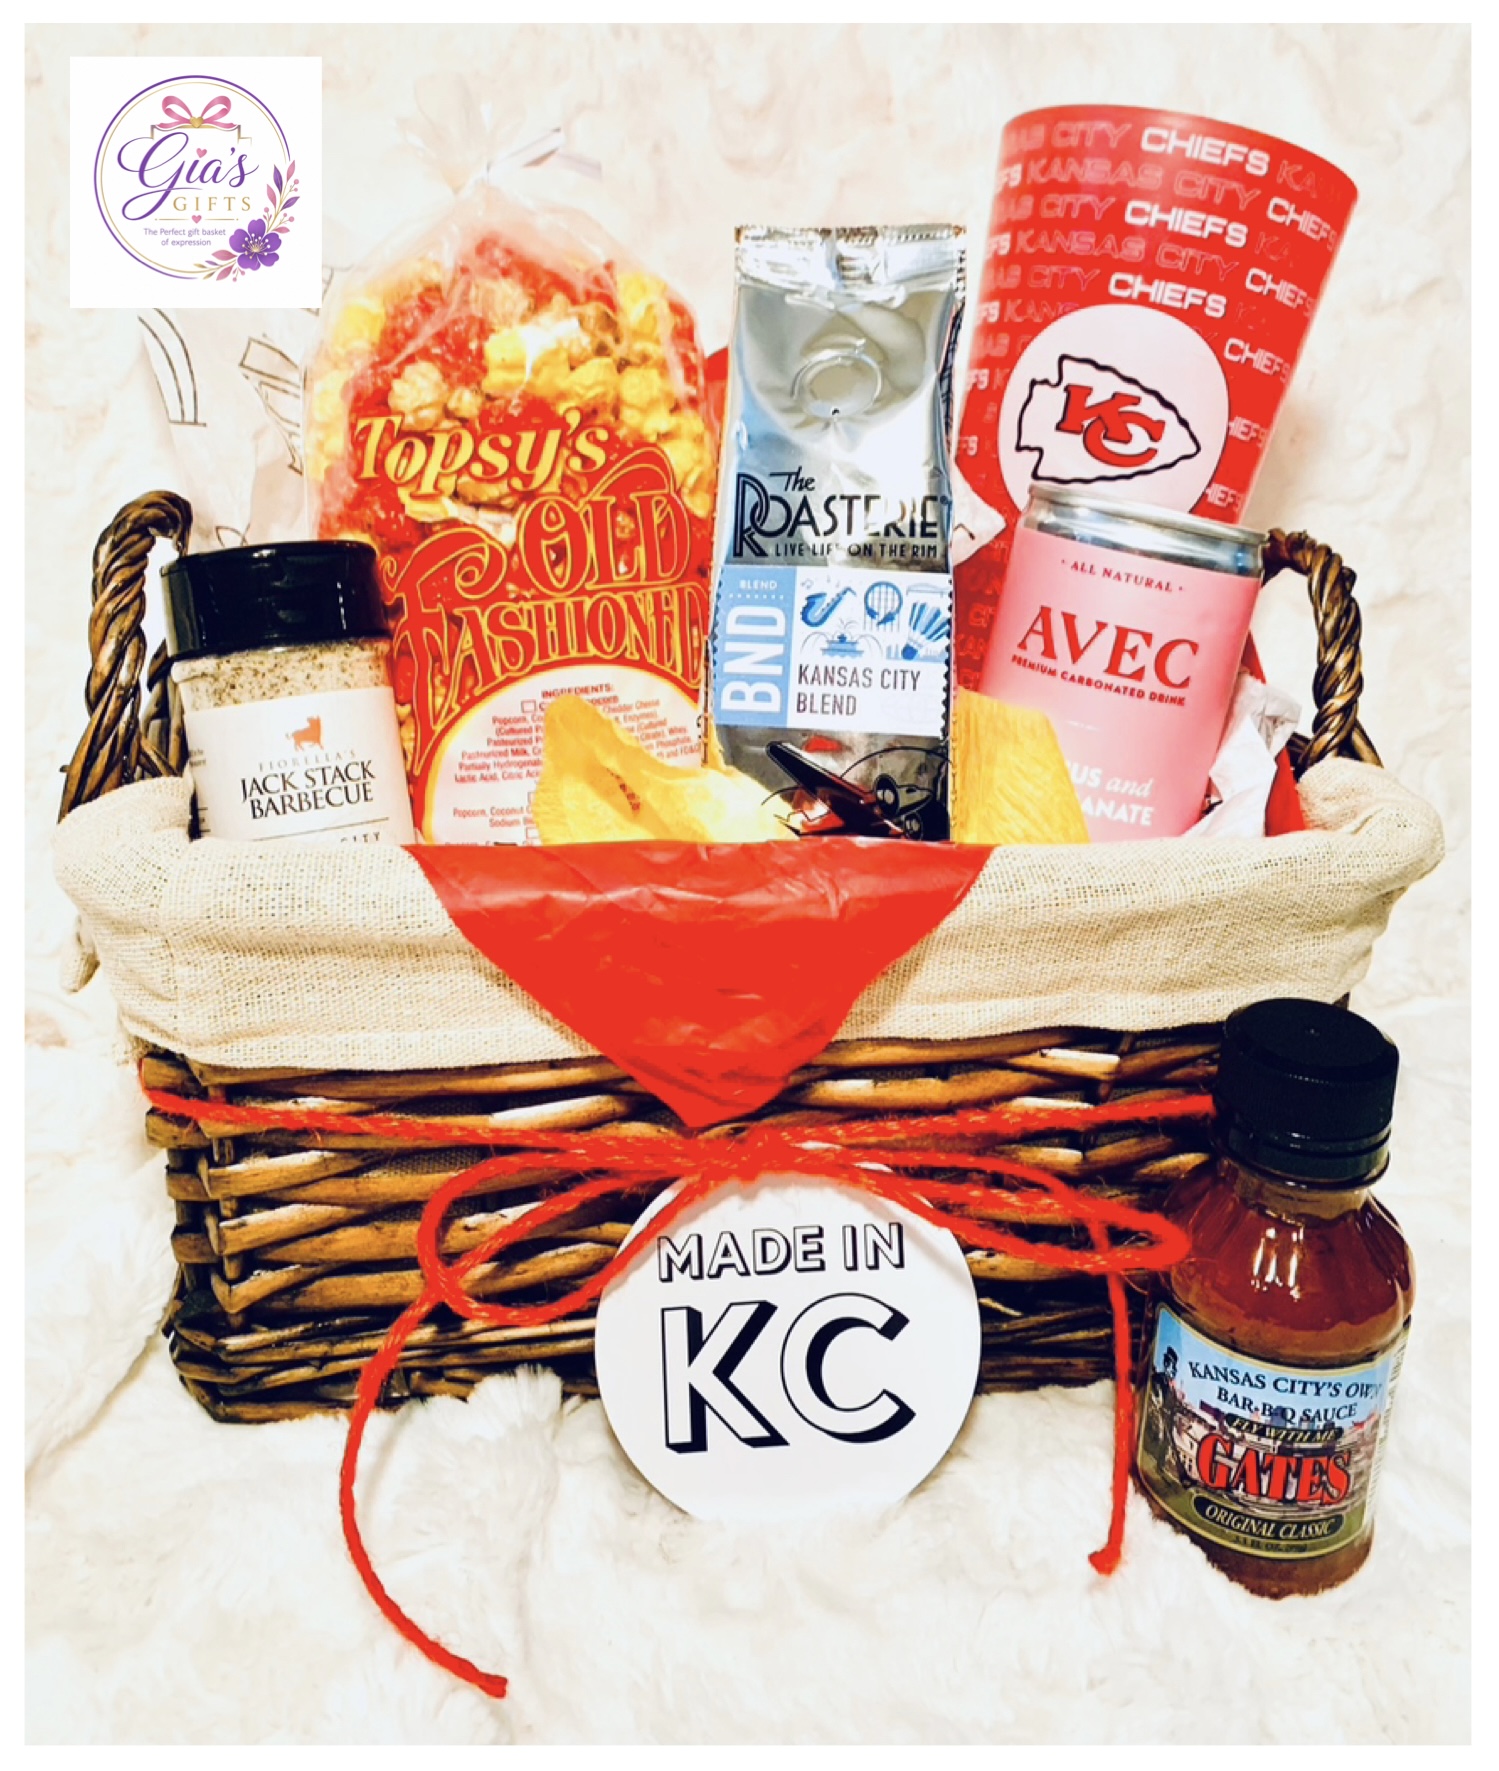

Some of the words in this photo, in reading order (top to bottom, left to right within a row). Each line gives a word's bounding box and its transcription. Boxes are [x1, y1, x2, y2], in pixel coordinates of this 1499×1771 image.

[1051, 120, 1132, 149] CITY
[1140, 126, 1270, 177] CHIEFS
[1026, 158, 1162, 190] KANSAS
[1174, 171, 1261, 211] CITY
[1266, 196, 1338, 252] CHIEFS
[1040, 193, 1116, 221] CITY
[1124, 199, 1249, 248] CHIEFS
[1015, 228, 1146, 262] KANSAS
[1156, 243, 1239, 281] CITY
[1245, 267, 1314, 318] CHIEFS
[1027, 264, 1101, 292] CITY
[1107, 272, 1227, 319] CHIEFS
[1223, 337, 1291, 384] CHIEFS
[355, 407, 611, 496] Topsy's
[1055, 383, 1166, 468] KC
[769, 466, 816, 491] The
[517, 446, 691, 597] OLD
[733, 471, 938, 558] ROASTERIE
[775, 543, 805, 558] LIVE
[811, 543, 839, 558] LIF
[847, 542, 873, 558] ON
[880, 543, 906, 559] THE
[912, 544, 938, 559] RIM
[1070, 560, 1097, 576] ALL
[1101, 568, 1173, 593] NATURAL
[739, 579, 778, 590] BLEND
[381, 526, 708, 775] FASHIONED
[720, 605, 787, 713] BND
[1016, 604, 1200, 690] AVEC
[796, 692, 857, 716] BLEND
[797, 663, 874, 689] KANSAS
[880, 668, 921, 692] CITY
[1011, 654, 1058, 678] PREMIUM
[1060, 671, 1146, 699] CARBONATED
[1148, 690, 1187, 707] DRINK
[240, 771, 299, 804] JACK
[304, 759, 377, 789] STACK
[258, 749, 356, 773] FIORELLA'S
[1106, 777, 1155, 798] and
[250, 781, 374, 820] BARBECUE
[656, 1225, 826, 1283] MADE
[841, 1221, 906, 1272] IN
[660, 1291, 917, 1454] KC
[1188, 1360, 1266, 1390] KANSAS
[1272, 1376, 1341, 1399] CITY'S
[1231, 1416, 1263, 1435] FLY
[1264, 1426, 1313, 1442] WITH
[1313, 1429, 1339, 1442] ME
[1301, 1402, 1358, 1424] SAUCE
[1195, 1432, 1351, 1506] GATES
[1204, 1504, 1277, 1538] ORIGINAL
[1279, 1518, 1337, 1540] CLASSIC
